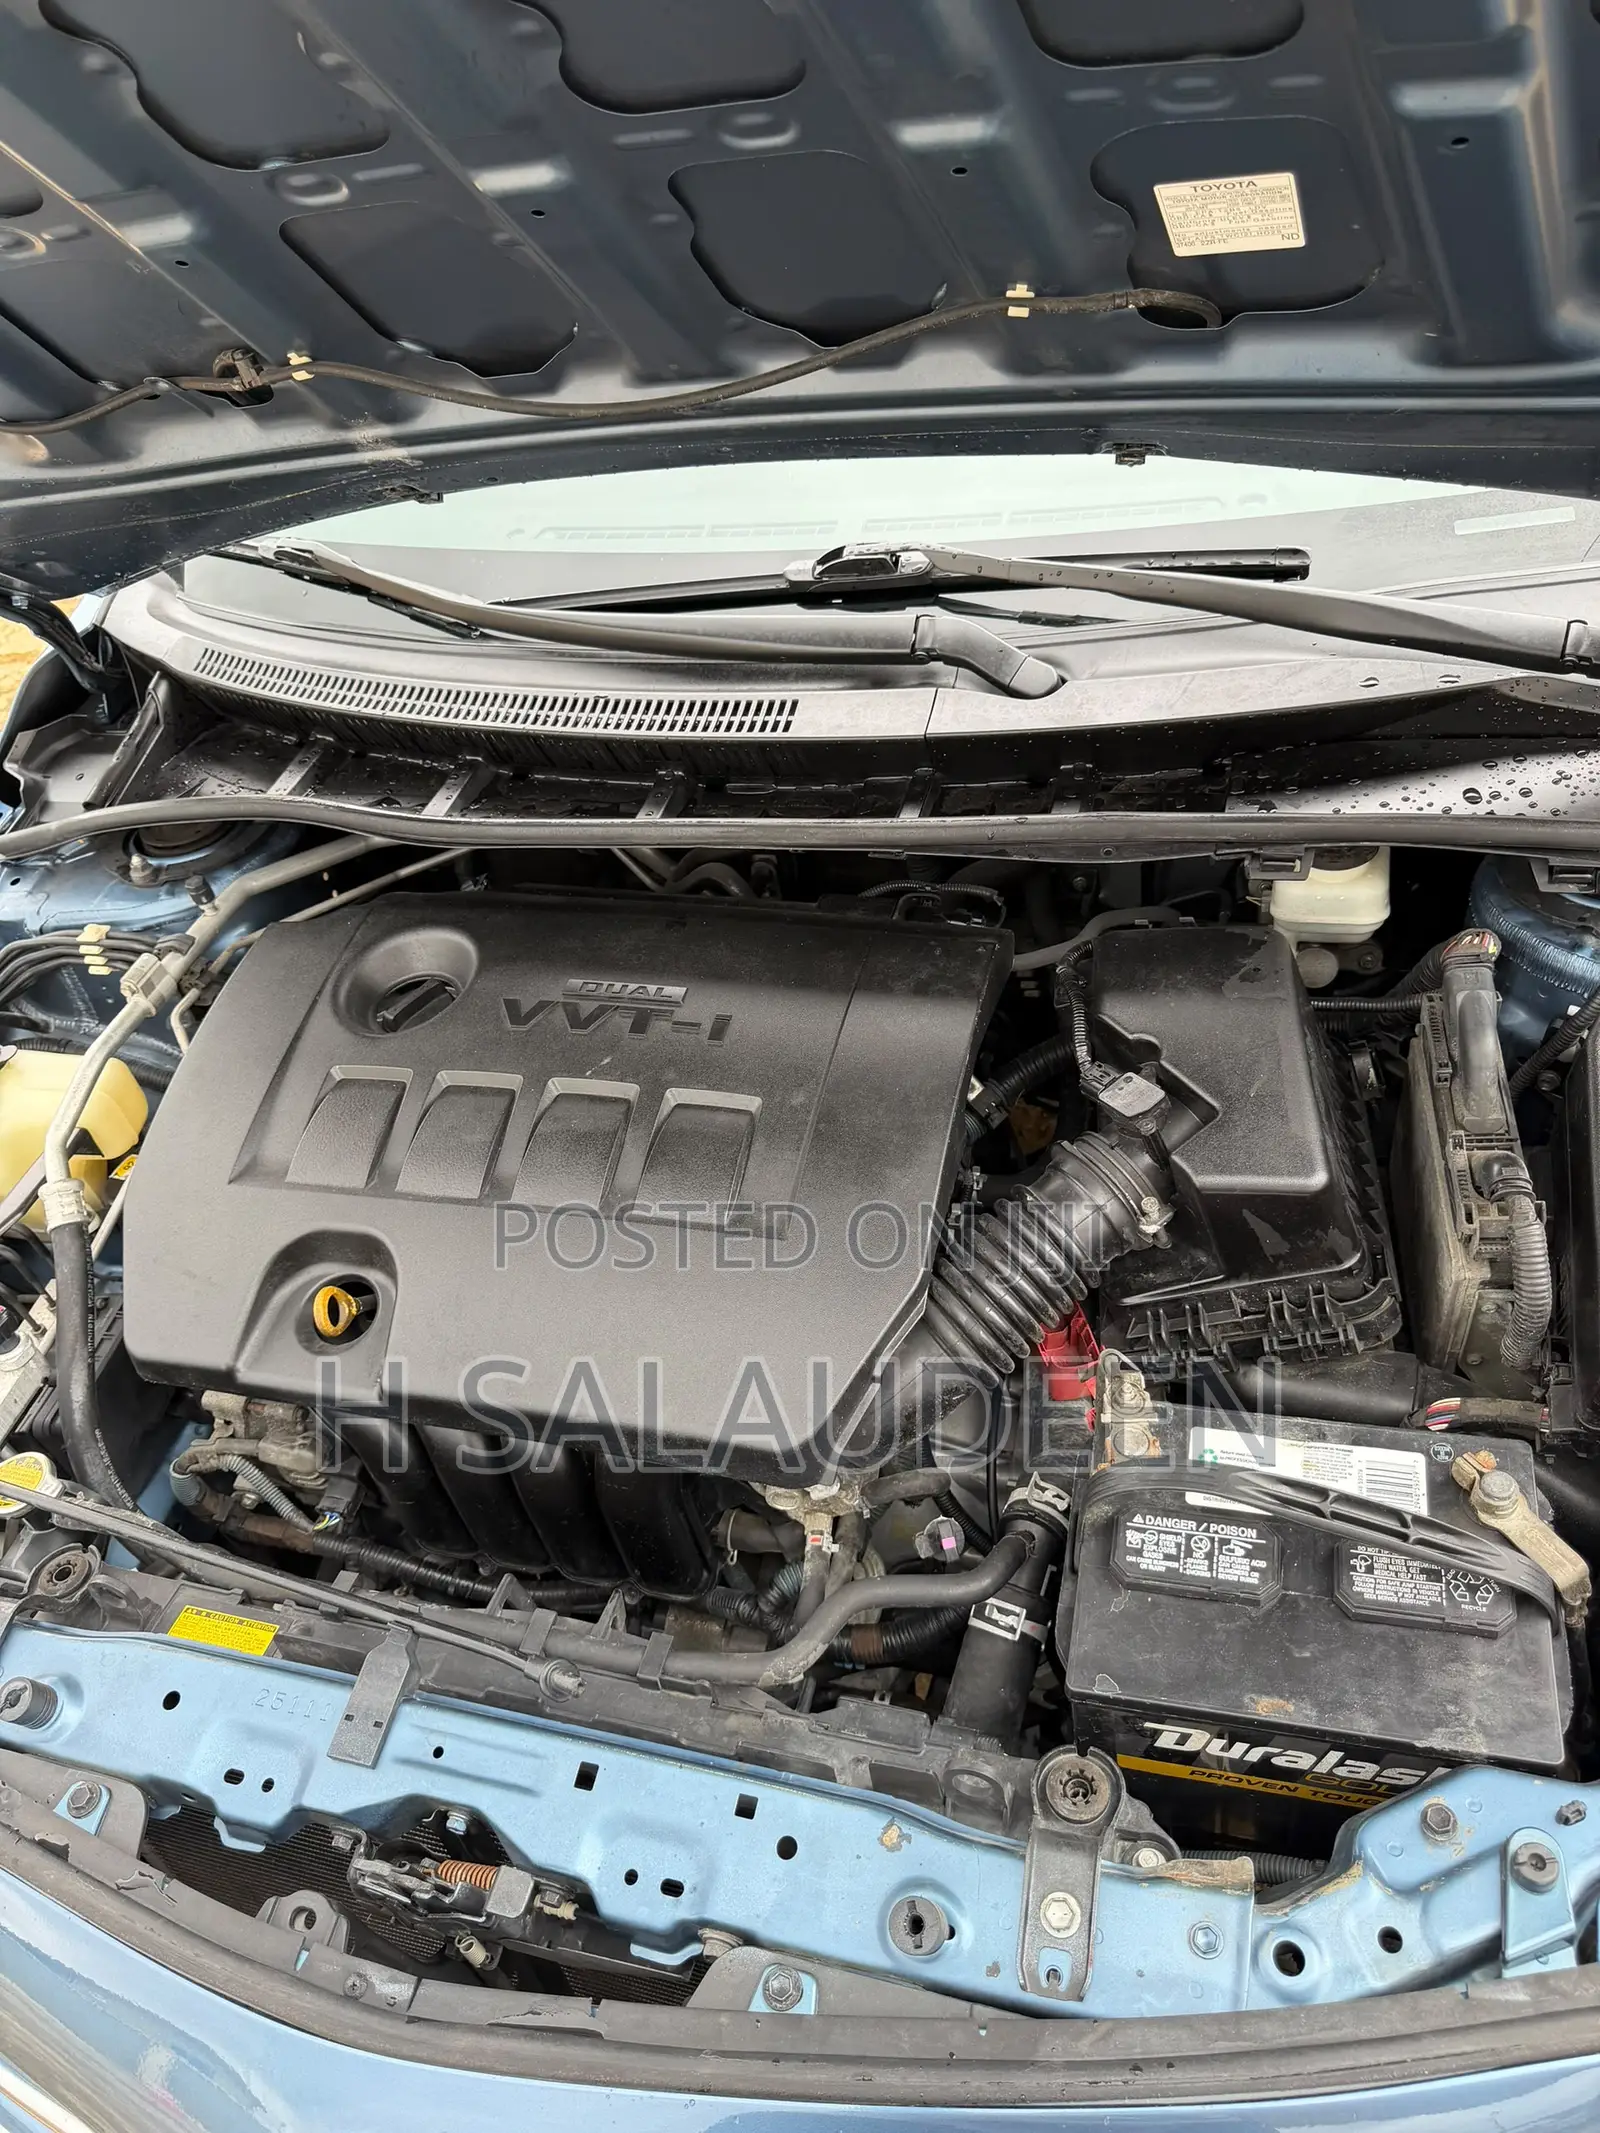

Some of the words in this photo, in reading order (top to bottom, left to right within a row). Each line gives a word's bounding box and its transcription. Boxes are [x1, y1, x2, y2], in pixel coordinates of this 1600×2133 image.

[1190, 181, 1257, 192] TOYOTA
[1229, 190, 1283, 199] CORPORATION
[579, 982, 673, 998] DUAL
[1146, 1515, 1197, 1530] DANGER
[1209, 1523, 1257, 1538] POISON
[1159, 1532, 1182, 1543] SHIELD
[1143, 1543, 1177, 1555] EXPLOSIVE
[1159, 1539, 1175, 1548] EYES
[1143, 1550, 1164, 1560] GASES
[1193, 1551, 1205, 1559] NO
[1373, 1555, 1390, 1564] FLUSH
[1391, 1558, 1405, 1566] EYES
[1218, 1554, 1250, 1566] SULFURIC
[1251, 1559, 1267, 1568] ACID
[1374, 1562, 1387, 1570] WITH
[1148, 1564, 1166, 1572] INJURY
[1218, 1566, 1249, 1577] BLINDNESS
[1250, 1571, 1260, 1579] OR
[1231, 1563, 1250, 1571] CAUSE
[1218, 1572, 1238, 1582] SEVERE
[1239, 1576, 1259, 1585] BURNS
[1374, 1568, 1397, 1577] MEDICAL
[1398, 1571, 1412, 1579] HELP
[1413, 1573, 1427, 1581] FAST
[1355, 1581, 1375, 1589] FOLLOW
[1376, 1583, 1411, 1593] INSTRUCTIONS
[1416, 1583, 1441, 1591] STARTING
[1378, 1594, 1398, 1602] SERVICE
[1416, 1594, 1441, 1602] AVAILABLE
[1461, 1604, 1487, 1612] RECYCLE
[209, 1613, 239, 1624] CAUTION
[1189, 1770, 1298, 1792] PROVEN
[1309, 1790, 1382, 1806] TOUG
[1305, 1773, 1400, 1795] GOL
